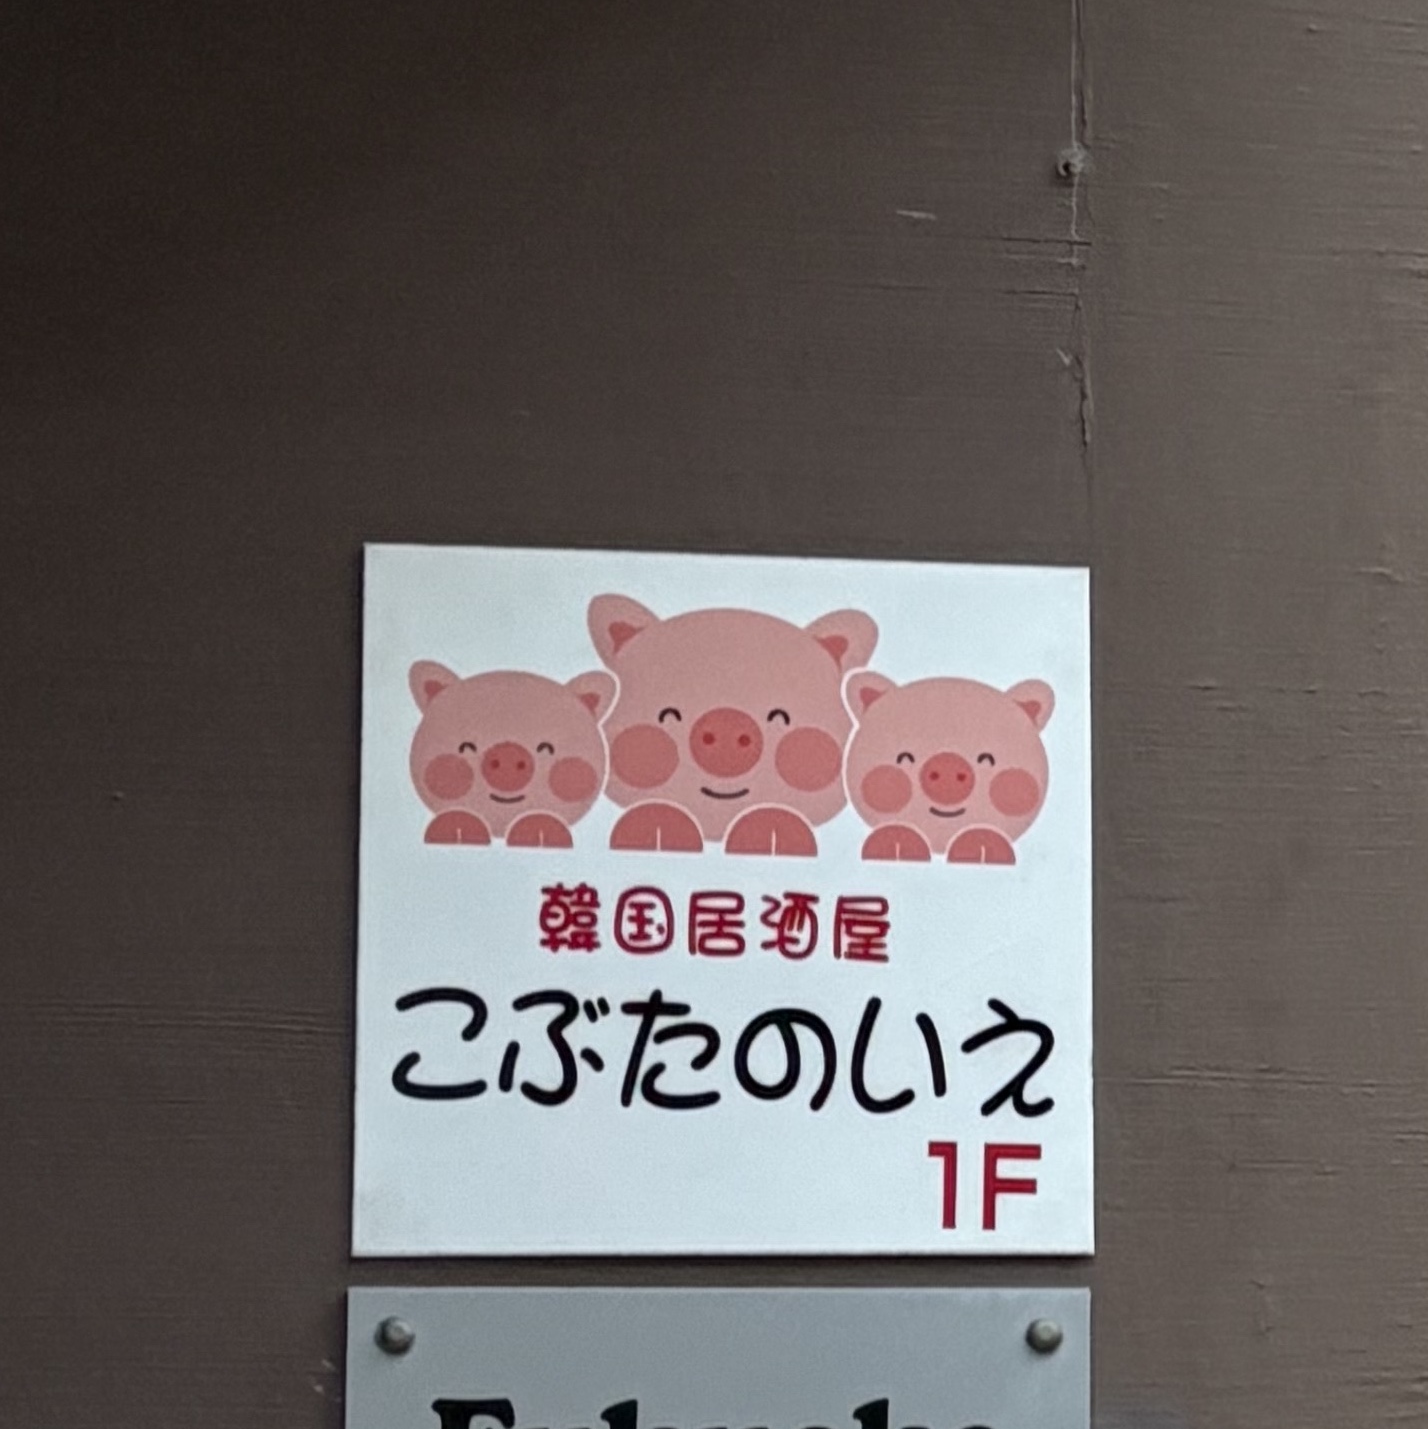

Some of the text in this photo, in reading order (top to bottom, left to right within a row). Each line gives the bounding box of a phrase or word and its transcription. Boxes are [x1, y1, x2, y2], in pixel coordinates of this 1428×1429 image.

[538, 883, 891, 963] 韓国居酒屋
[391, 987, 1056, 1118] こぶたのいえ
[927, 1140, 1042, 1231] 1F
